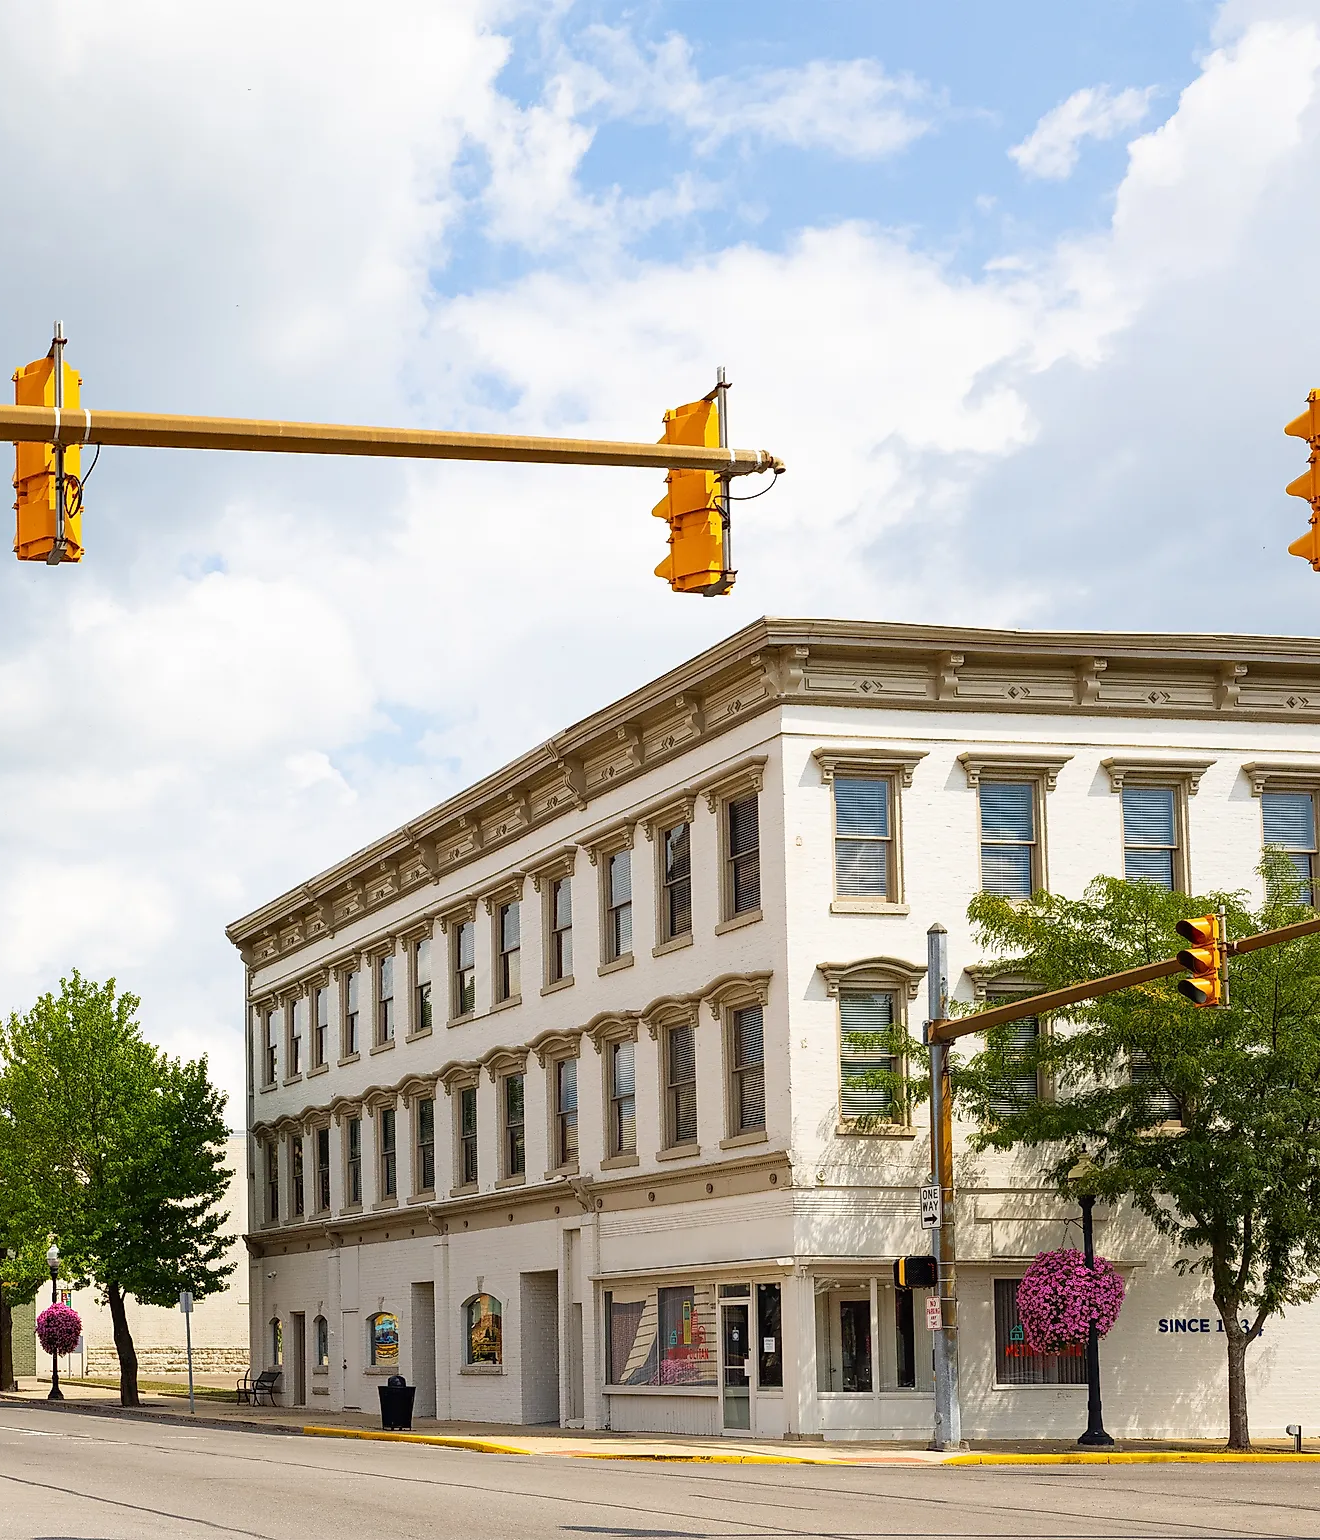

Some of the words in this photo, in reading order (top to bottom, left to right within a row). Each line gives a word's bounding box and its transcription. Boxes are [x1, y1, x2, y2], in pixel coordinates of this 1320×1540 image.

[923, 1189, 938, 1200] ONE
[923, 1200, 938, 1212] WAY
[1158, 1319, 1210, 1333] SINCE
